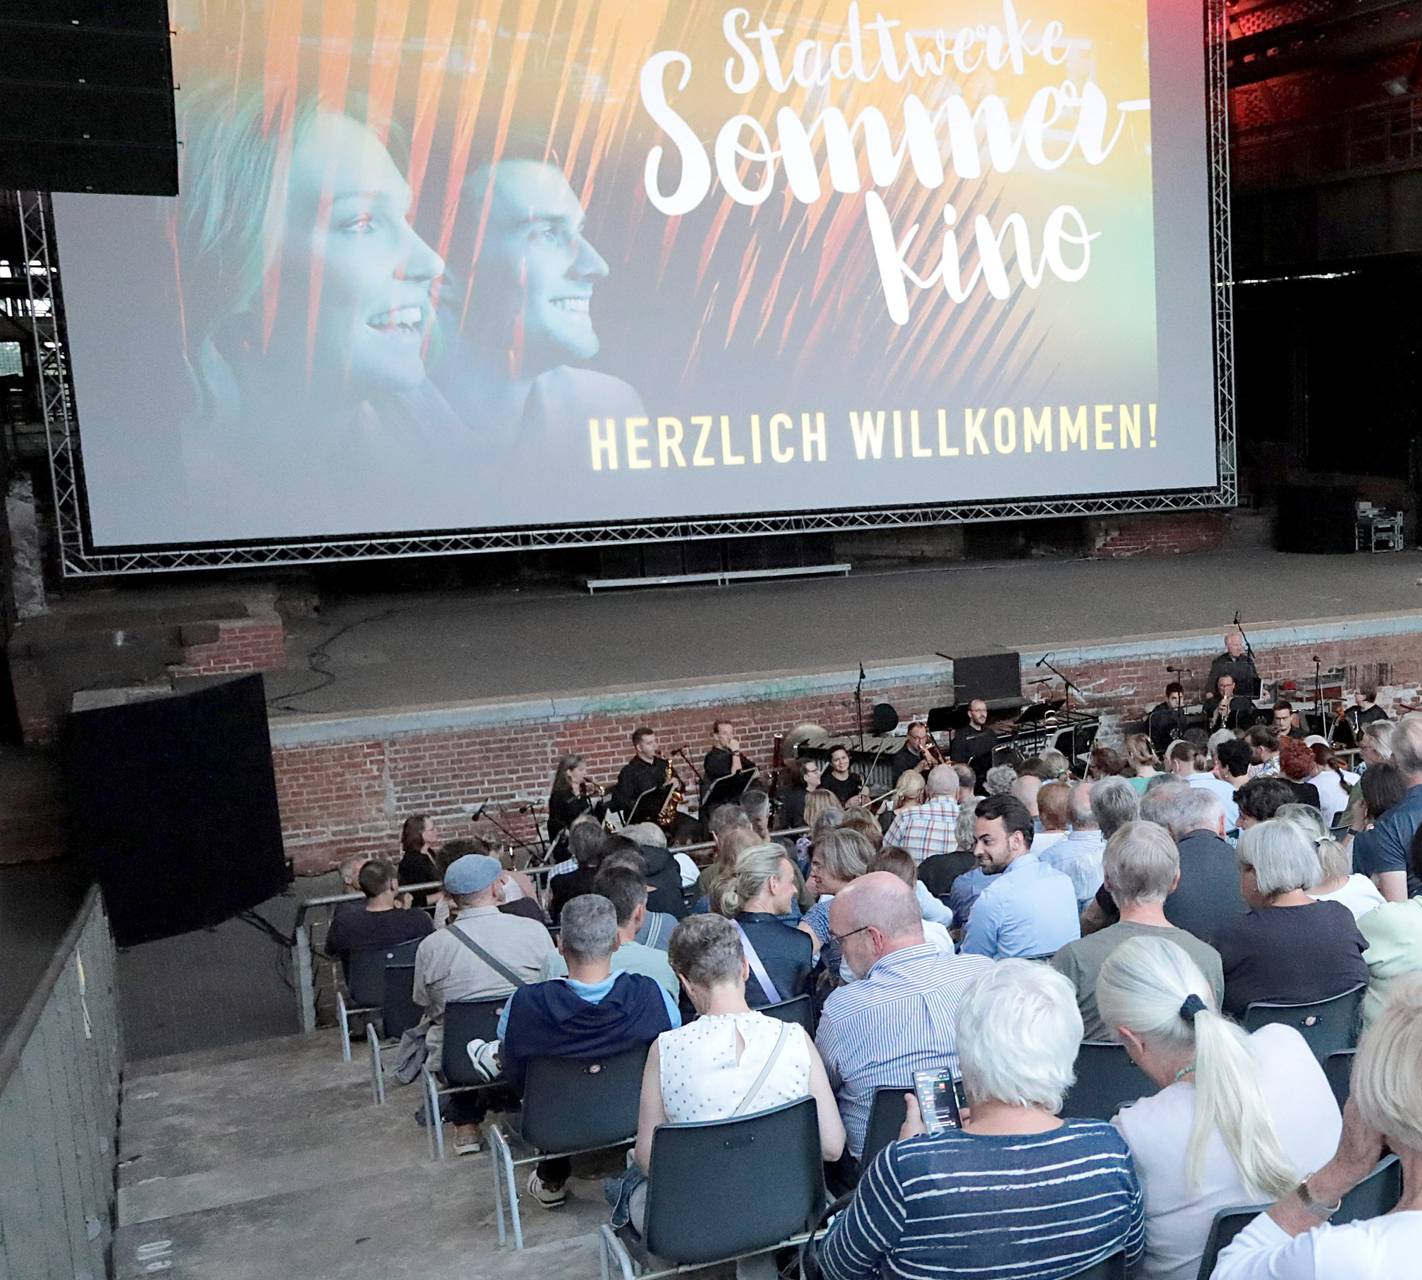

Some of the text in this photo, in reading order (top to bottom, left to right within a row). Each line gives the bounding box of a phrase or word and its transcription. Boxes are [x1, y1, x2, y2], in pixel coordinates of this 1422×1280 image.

[723, 0, 1072, 94] Stadtwerke
[640, 50, 1151, 215] Sommer-
[865, 190, 1101, 325] kino
[588, 403, 1159, 471] HERZLICH WILLKOMMEN!
